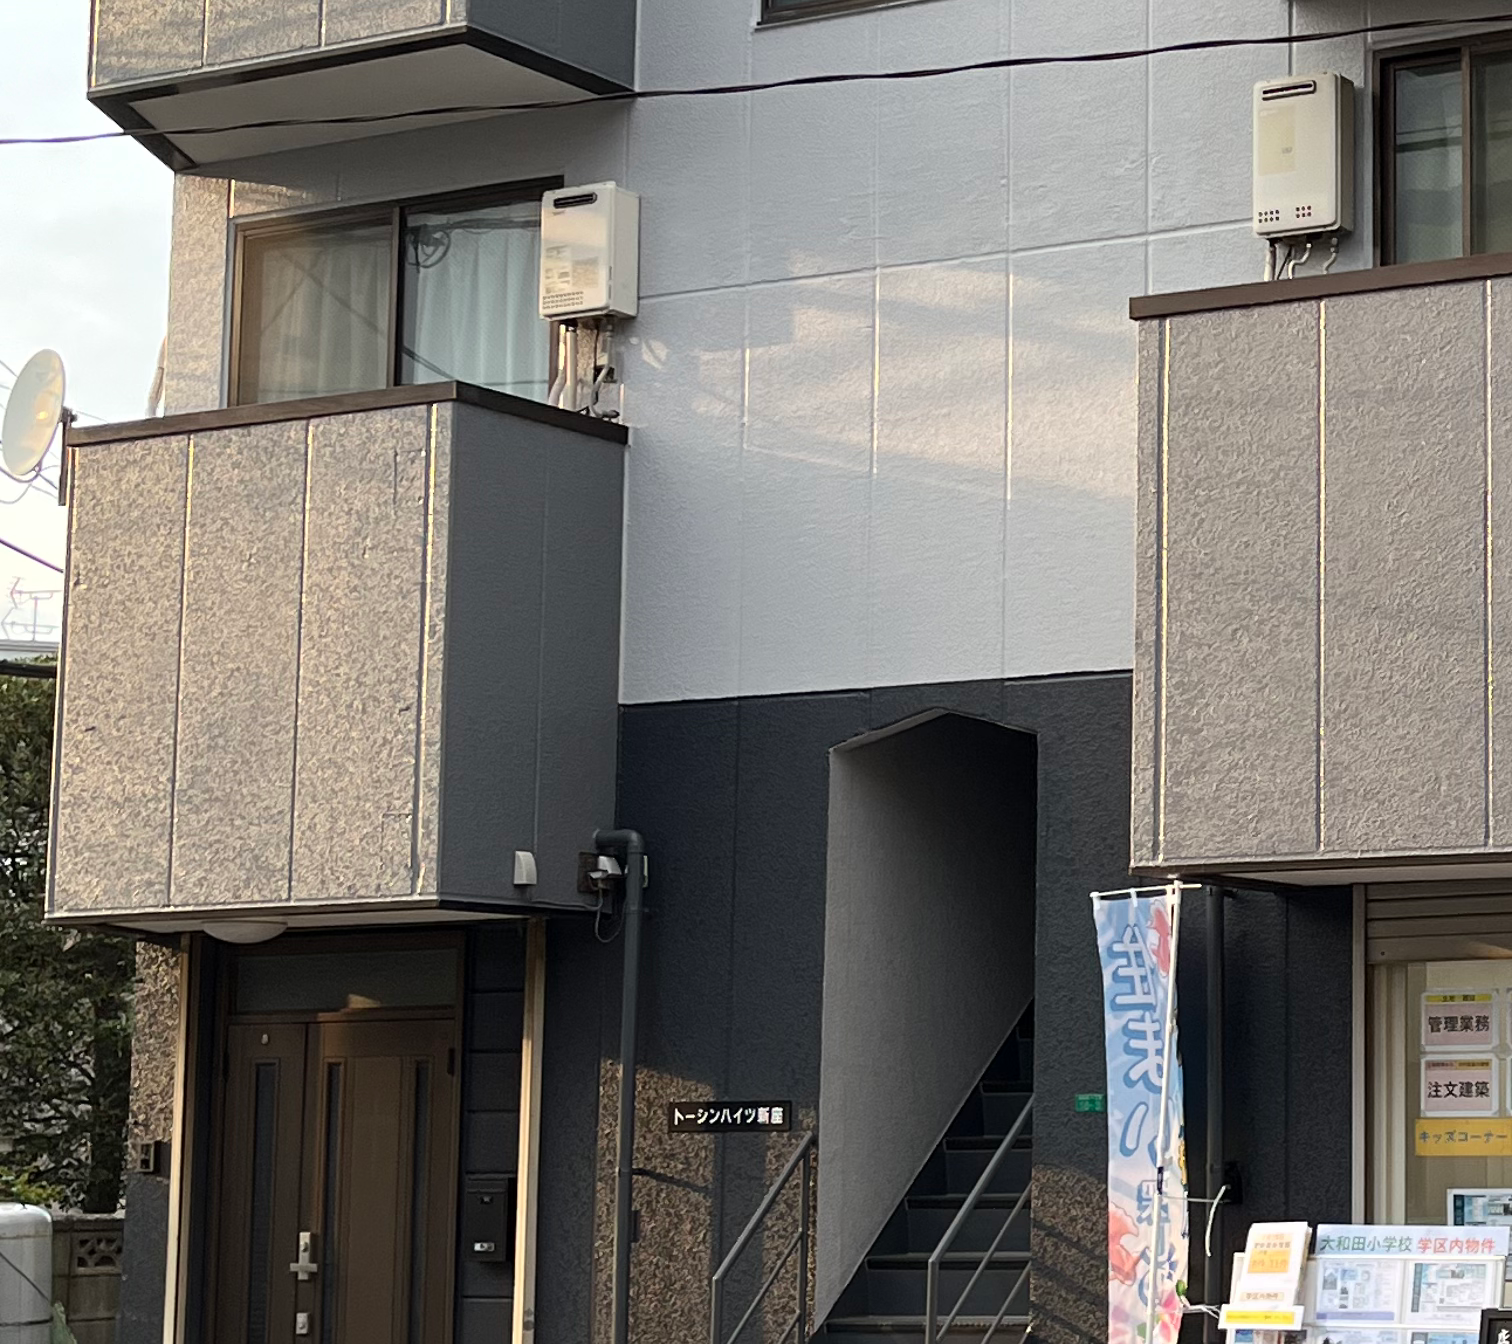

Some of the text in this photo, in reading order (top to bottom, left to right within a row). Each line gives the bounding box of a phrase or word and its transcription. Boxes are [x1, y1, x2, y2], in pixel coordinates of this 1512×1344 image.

[1428, 1014, 1490, 1033] 管理業務
[1427, 1080, 1490, 1099] 注文建築
[673, 1106, 784, 1126] トーシンハイツ新座
[1419, 1130, 1508, 1143] キッズコーナー
[1319, 1234, 1496, 1254] 大和田小学校 学区内物件
